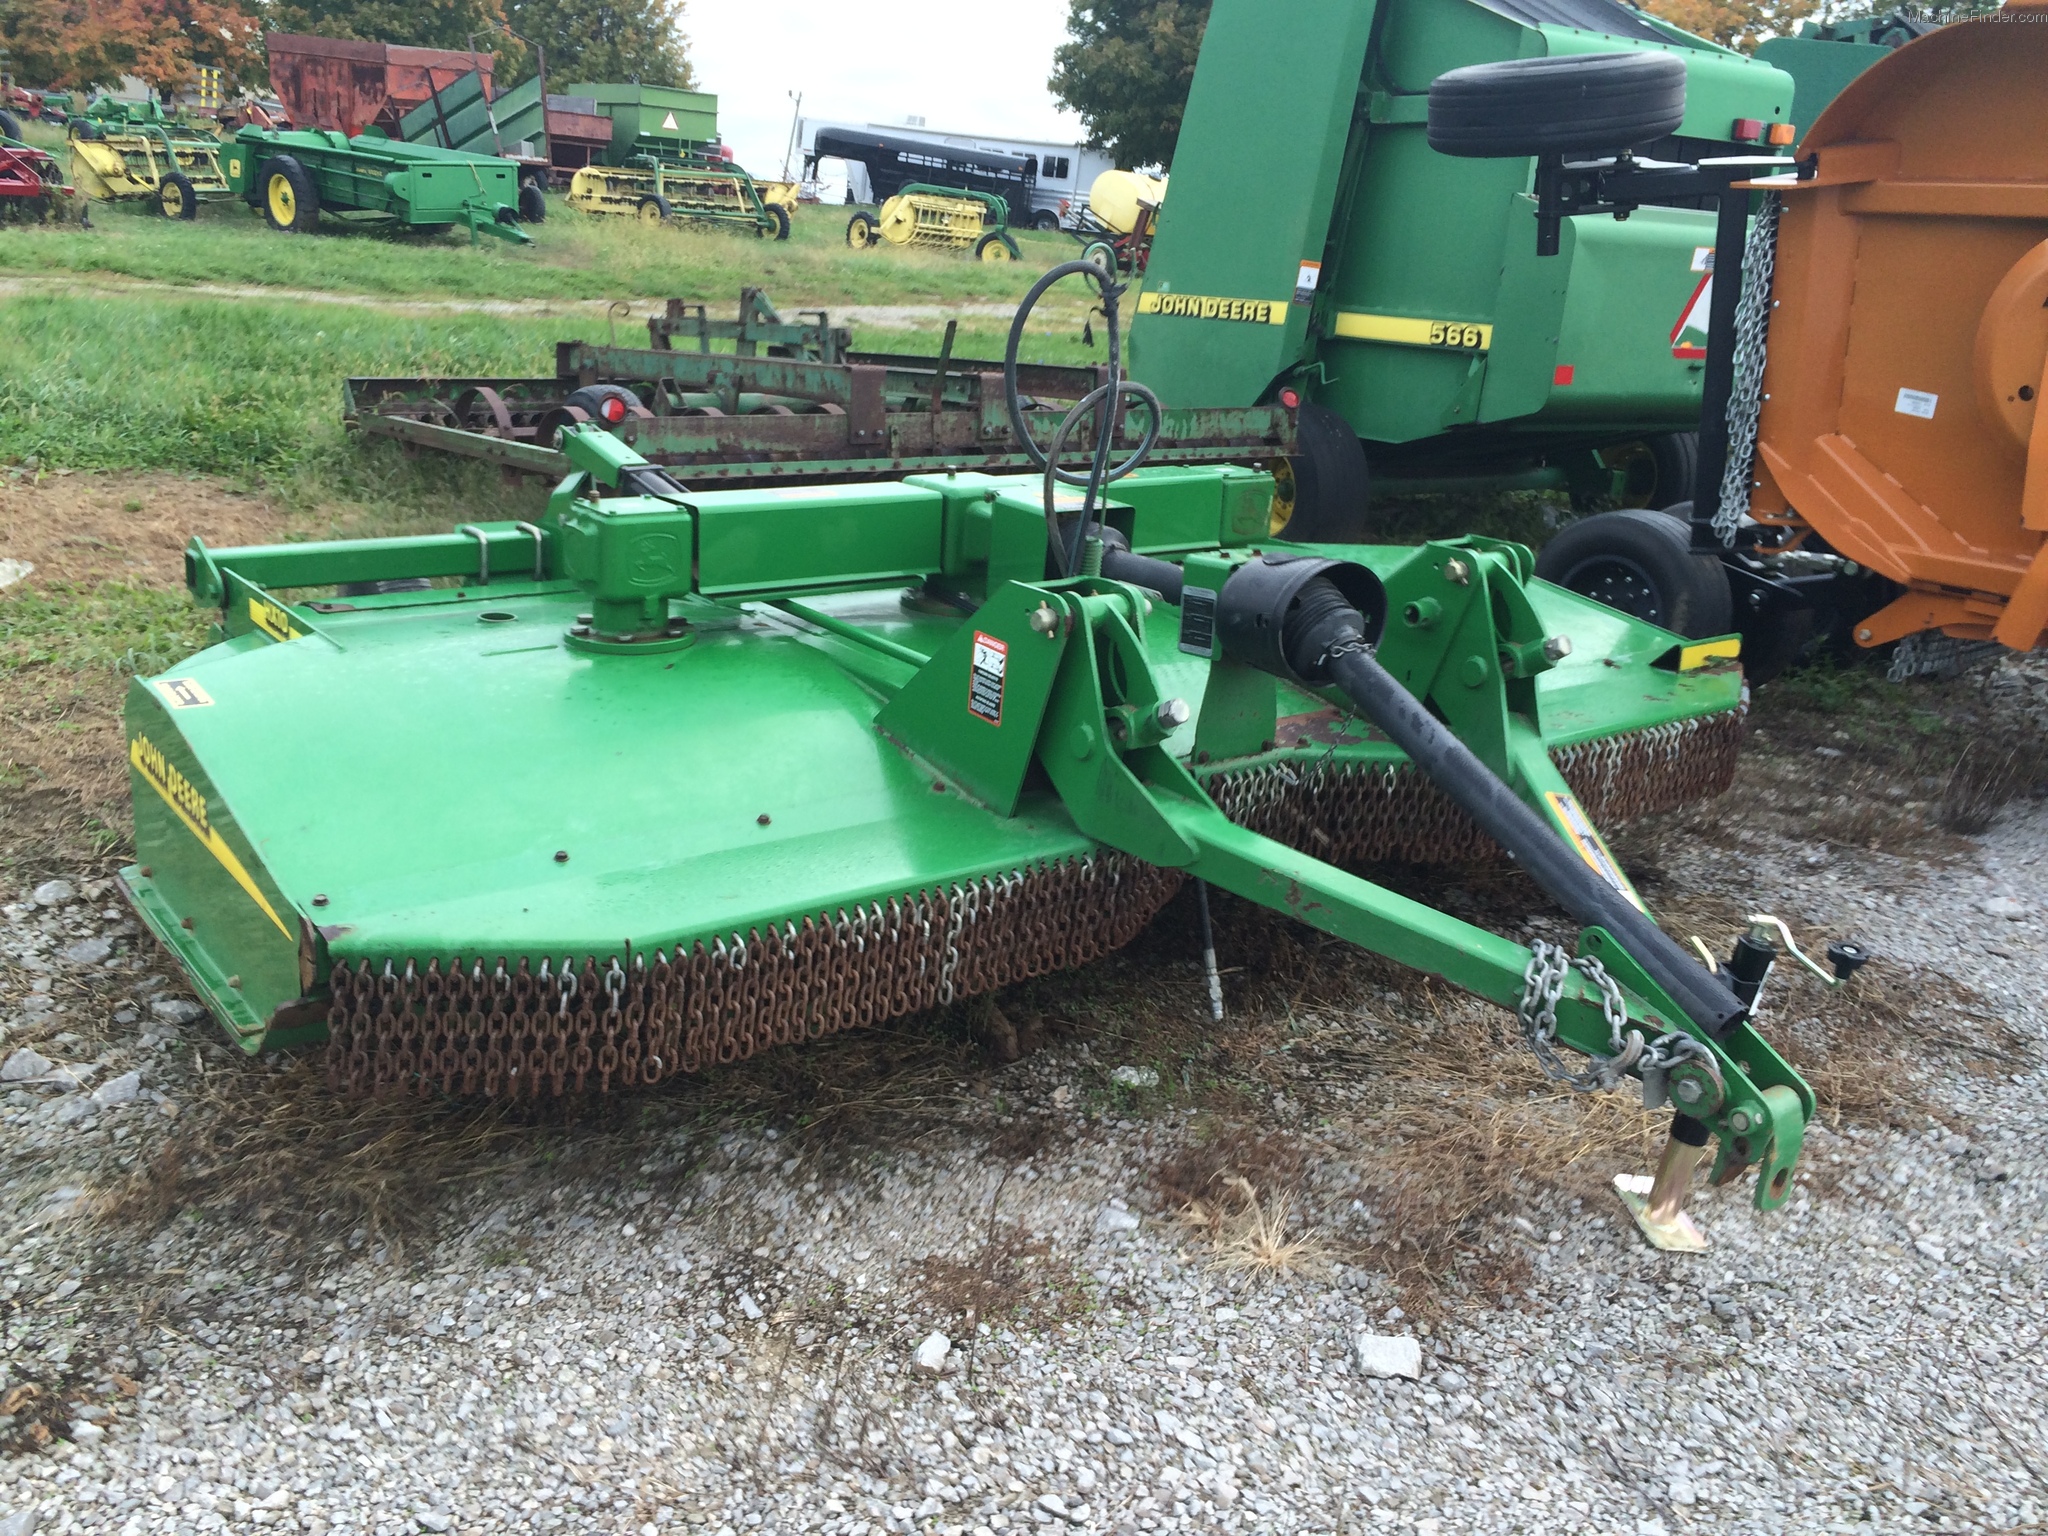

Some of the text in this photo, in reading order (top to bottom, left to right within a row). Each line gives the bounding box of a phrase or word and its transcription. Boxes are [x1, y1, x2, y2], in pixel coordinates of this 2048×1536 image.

[1150, 294, 1271, 324] JOHN DEERE
[1430, 322, 1482, 349] 566
[139, 731, 209, 835] JOHN DEERE
